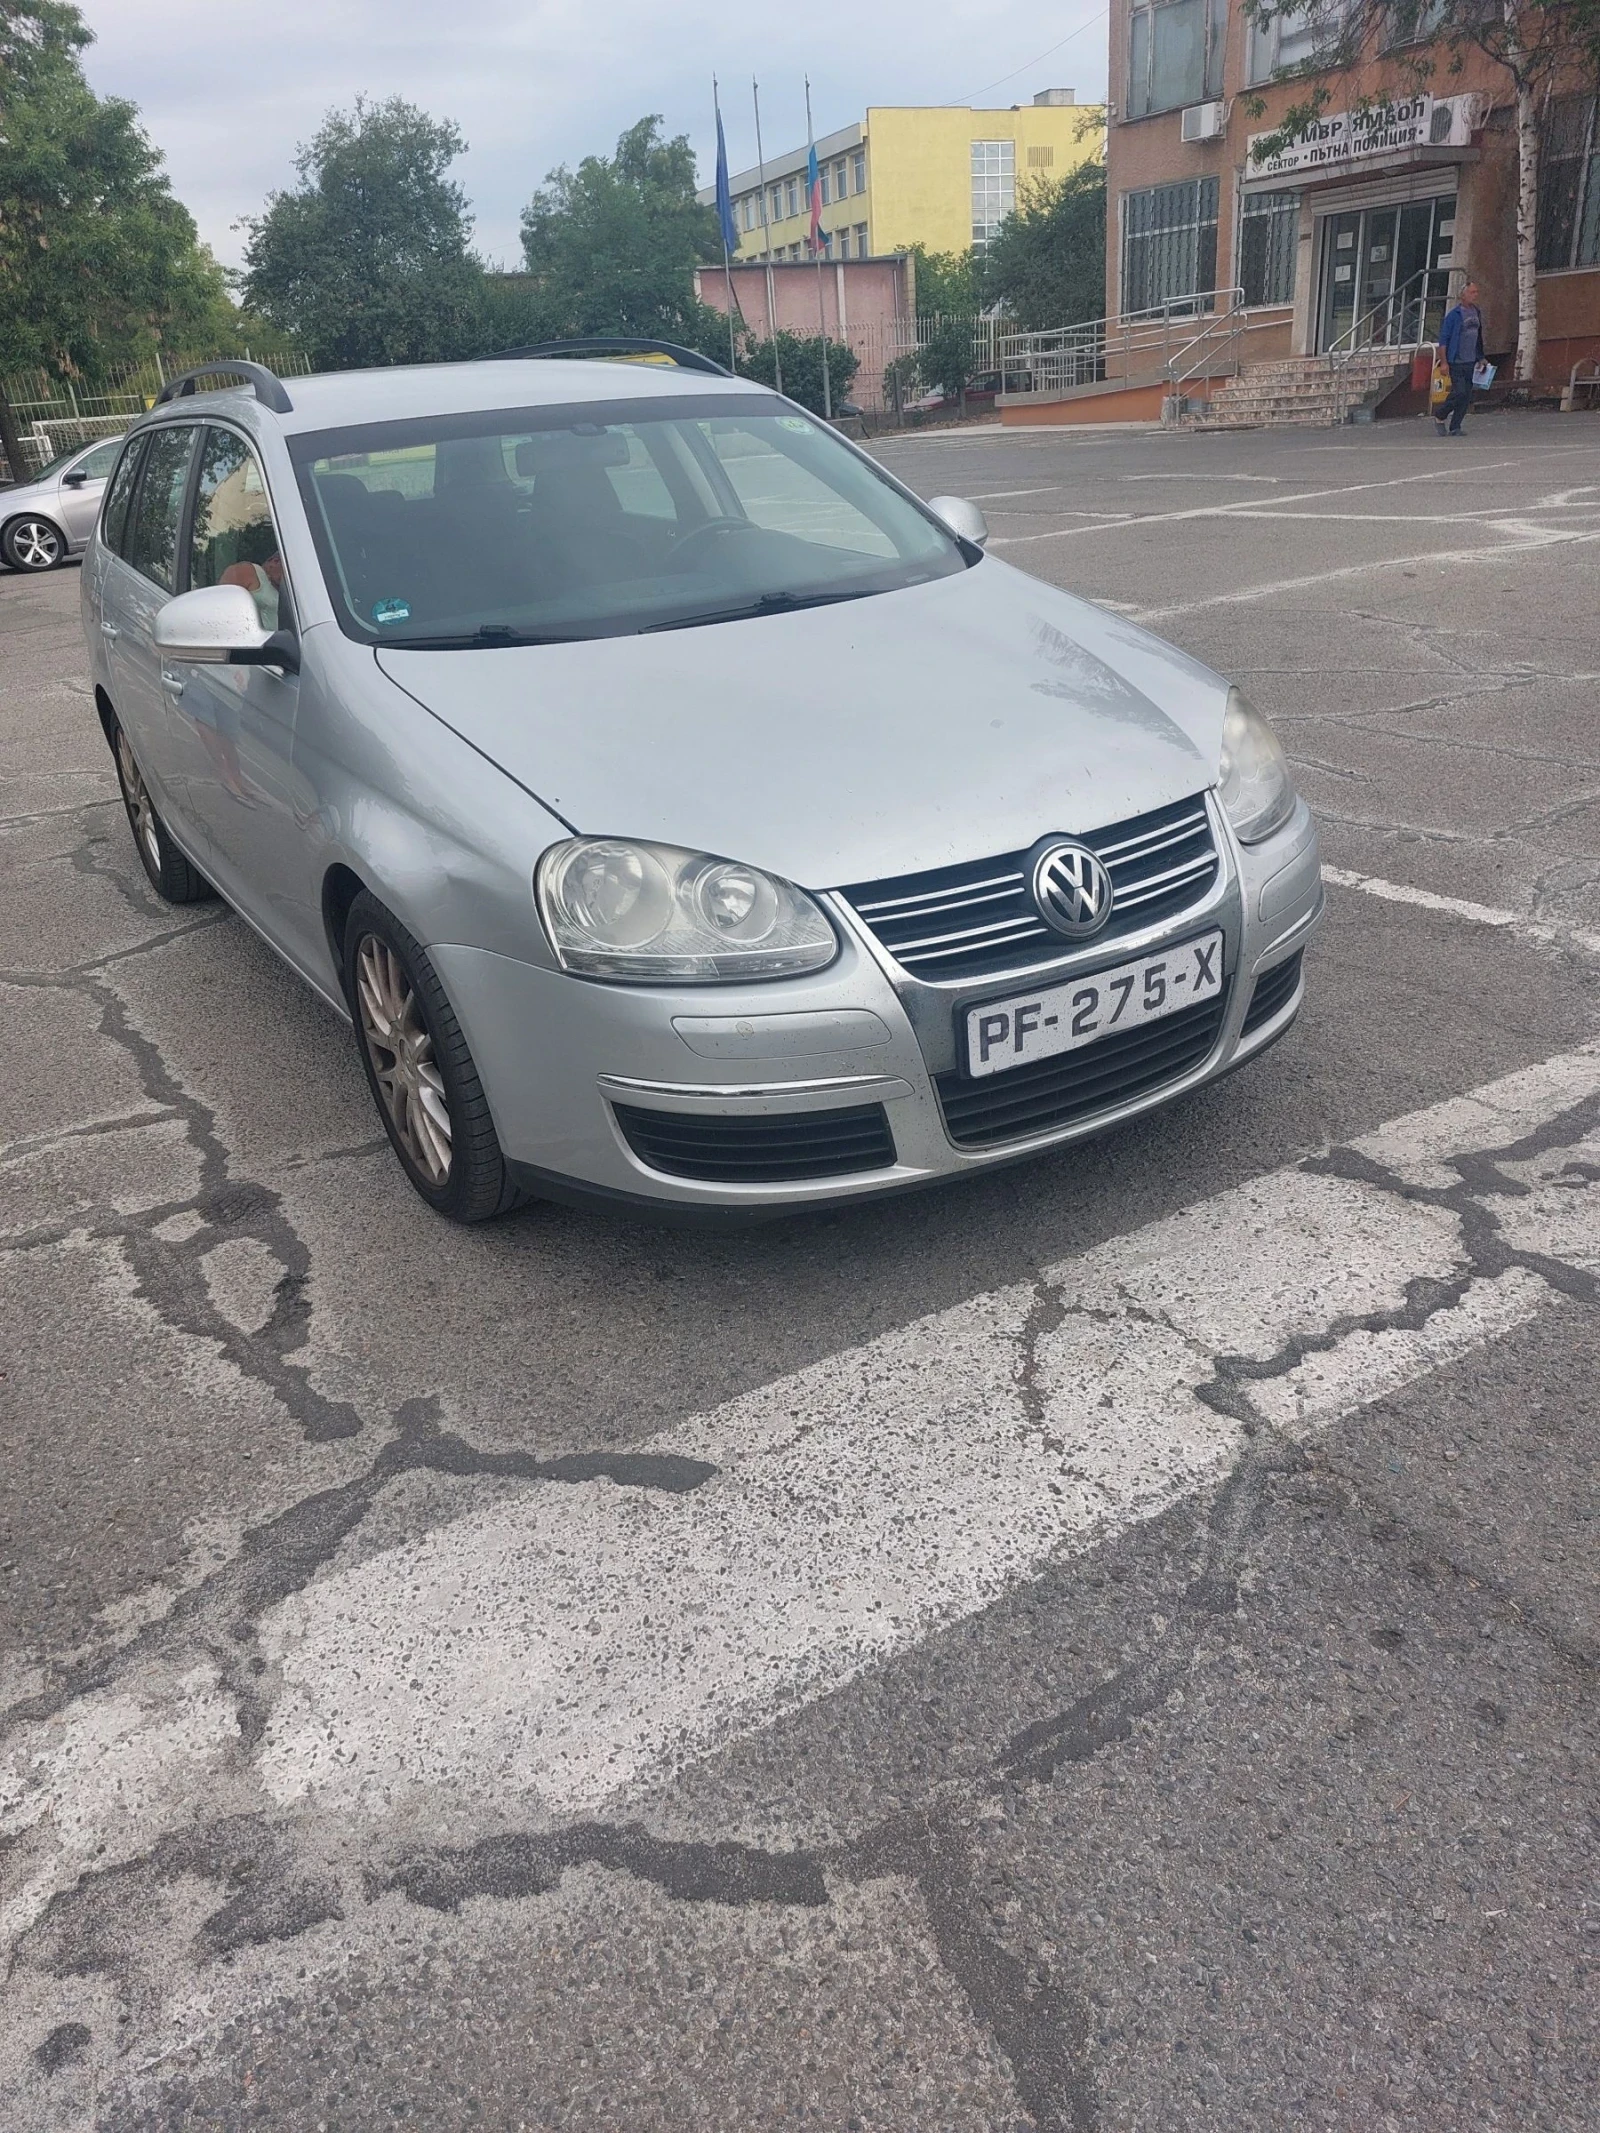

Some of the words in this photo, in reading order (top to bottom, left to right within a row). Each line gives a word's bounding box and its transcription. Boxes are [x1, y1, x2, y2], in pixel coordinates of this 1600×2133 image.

[1301, 121, 1342, 144] МВР
[1267, 156, 1300, 172] СЕКТОР
[1310, 142, 1349, 162] ПЪТНА
[979, 941, 1217, 1062] PF-275-X
